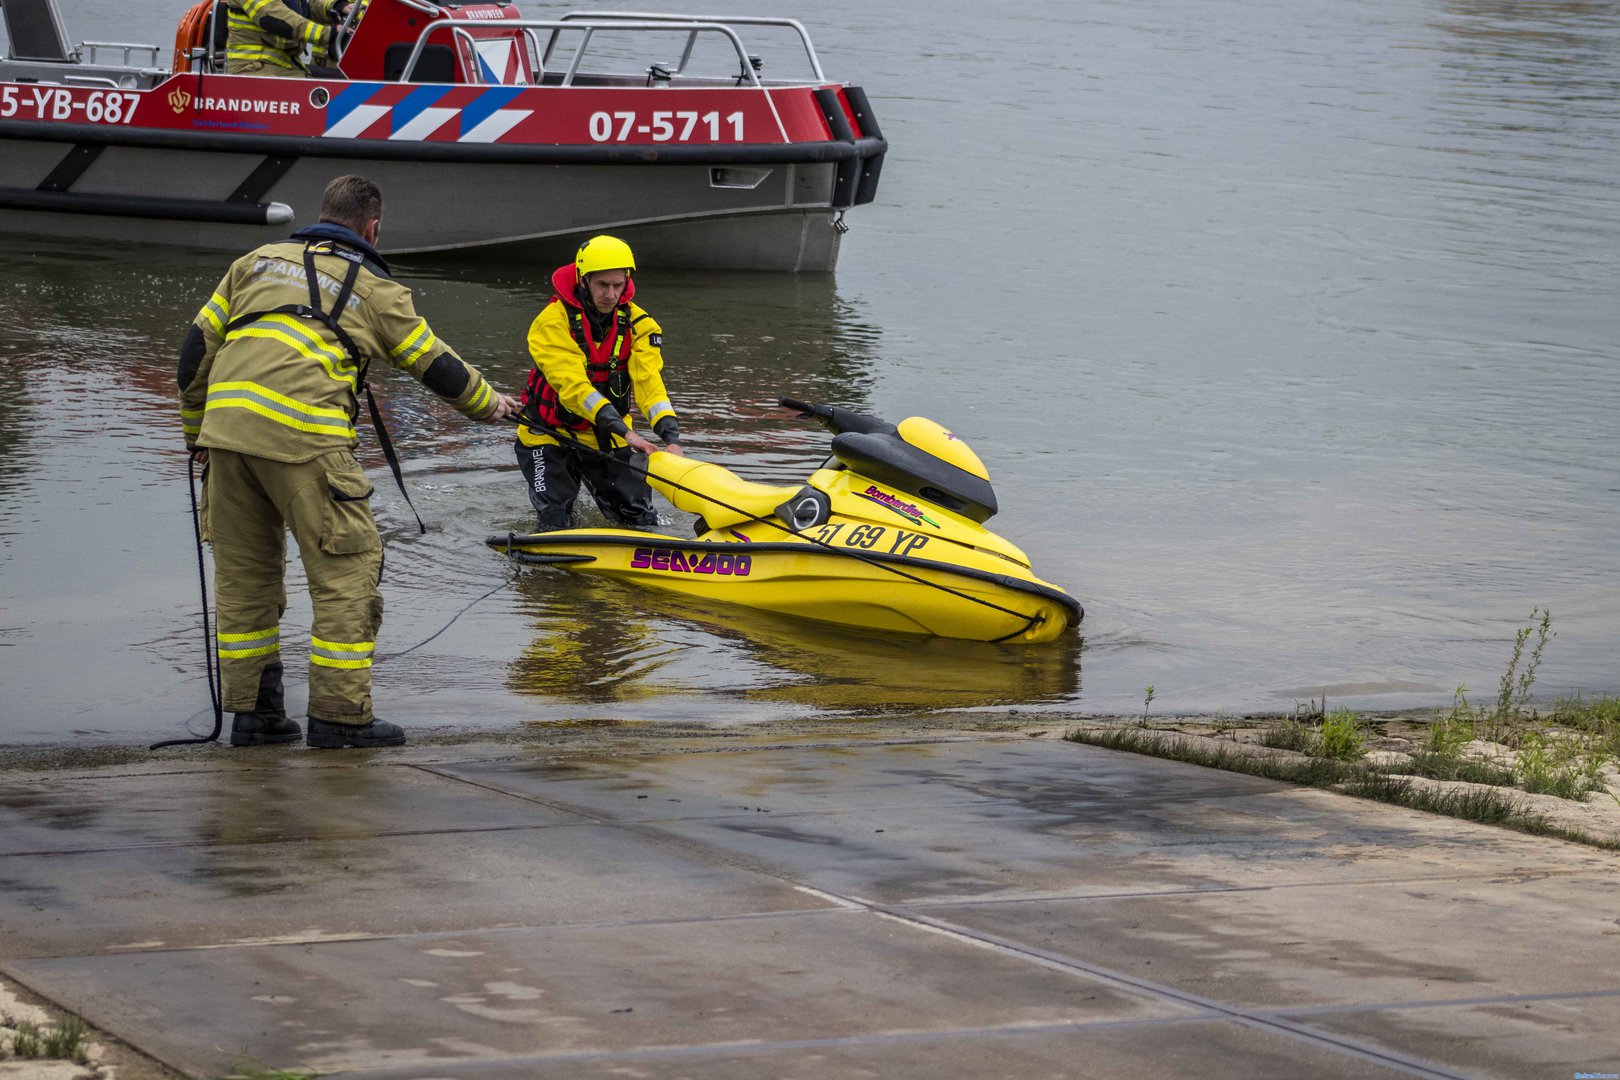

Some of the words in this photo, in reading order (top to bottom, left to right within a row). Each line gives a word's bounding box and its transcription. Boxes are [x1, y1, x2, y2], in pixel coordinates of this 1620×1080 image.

[1, 86, 141, 124] 5-YB-687
[194, 97, 300, 115] BRANDWEER
[589, 111, 744, 142] 07-5711
[864, 485, 924, 518] Bombardier
[845, 524, 886, 549] 69
[889, 530, 930, 557] YP
